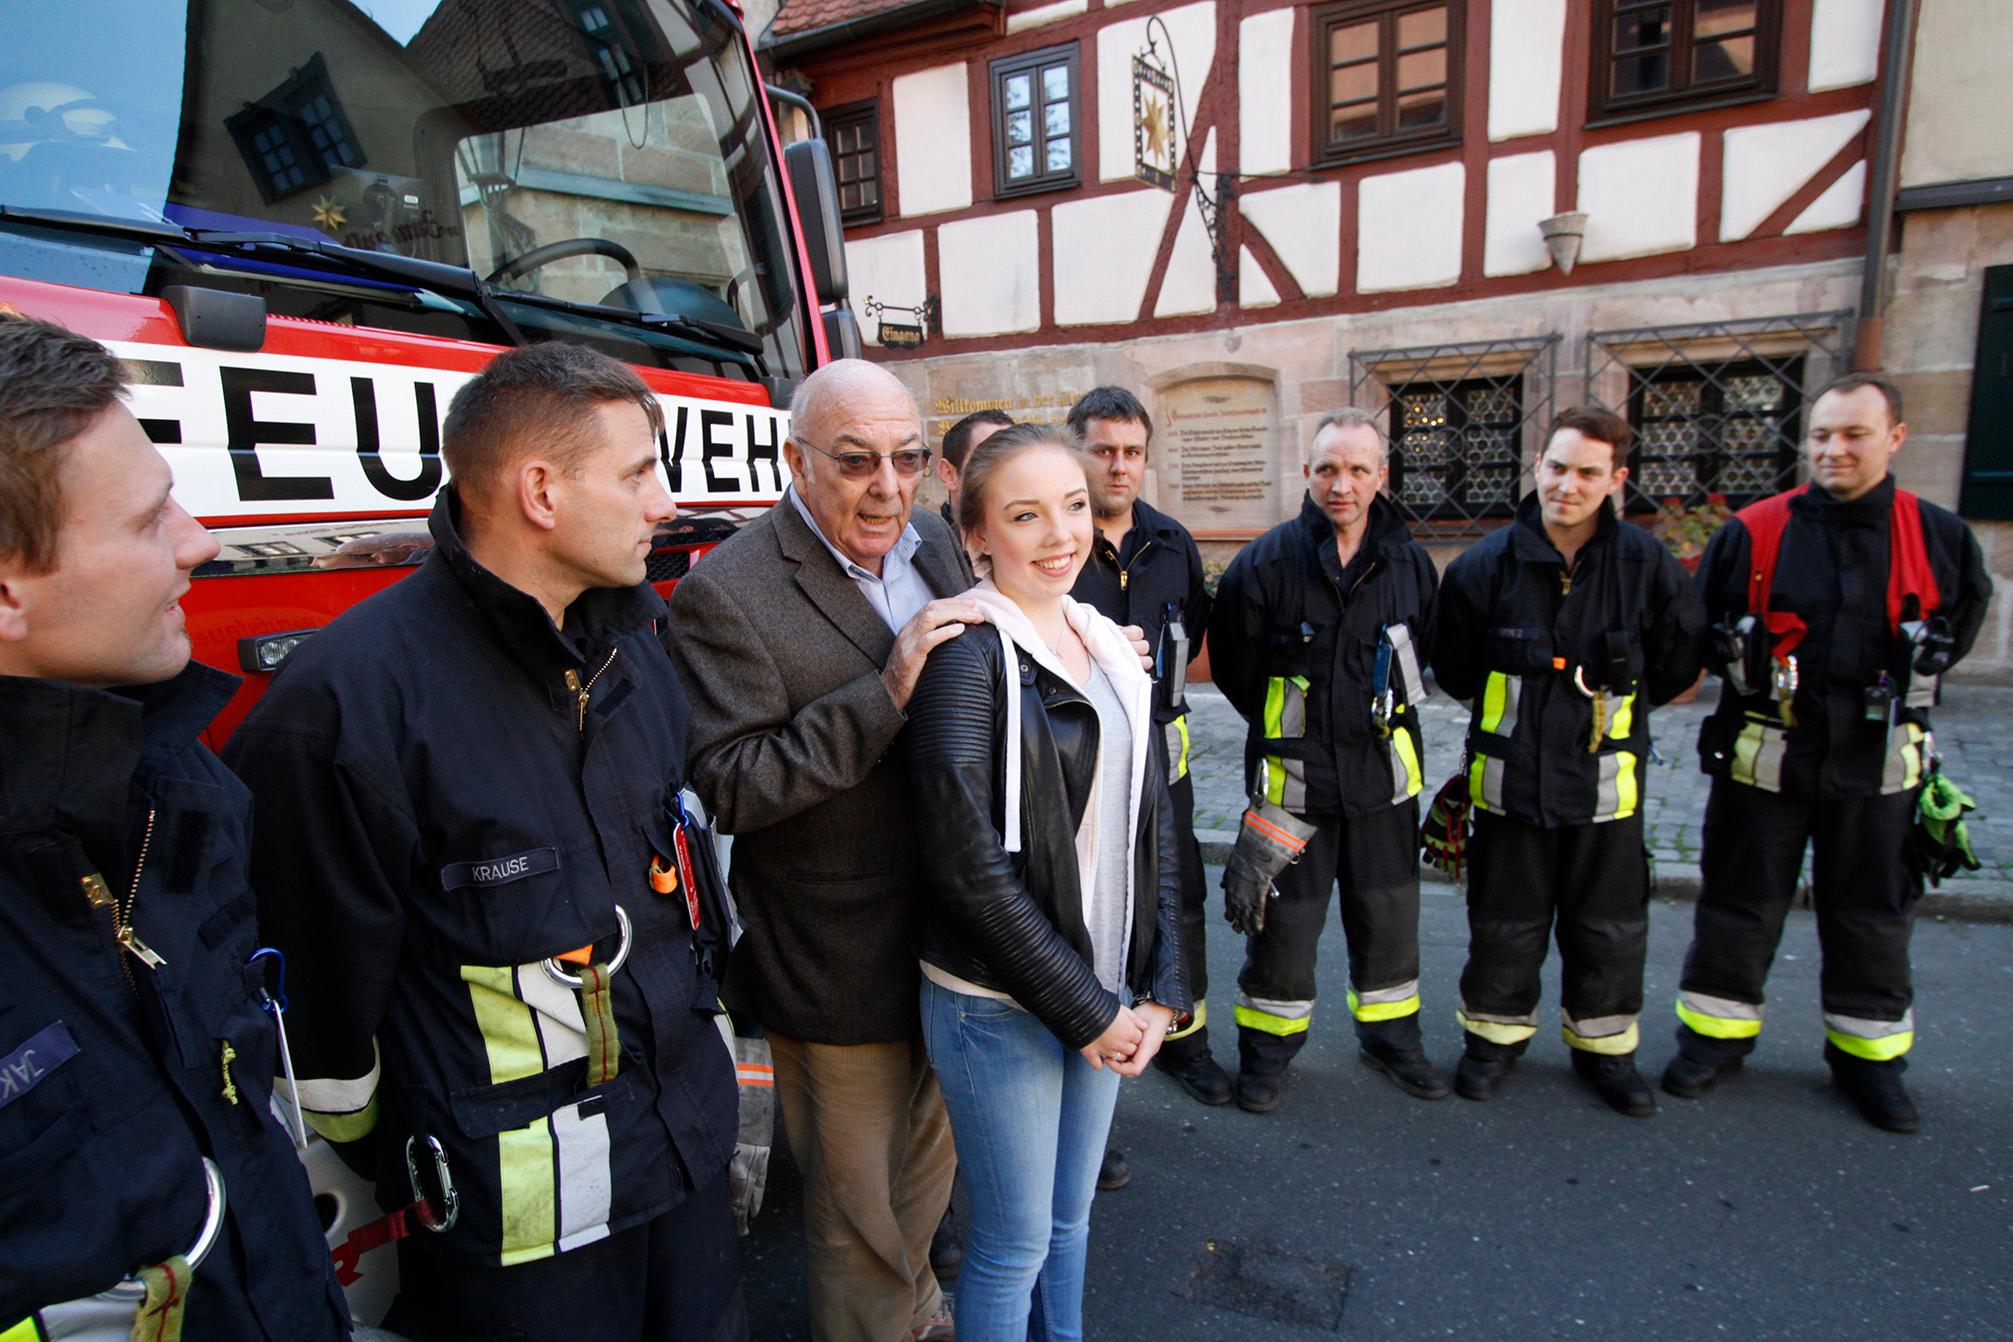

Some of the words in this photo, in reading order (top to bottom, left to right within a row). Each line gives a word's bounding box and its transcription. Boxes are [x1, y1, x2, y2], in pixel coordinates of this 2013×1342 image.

[882, 325, 920, 344] Eingang
[935, 397, 1012, 414] Willkommen
[472, 856, 529, 882] KRAUSE
